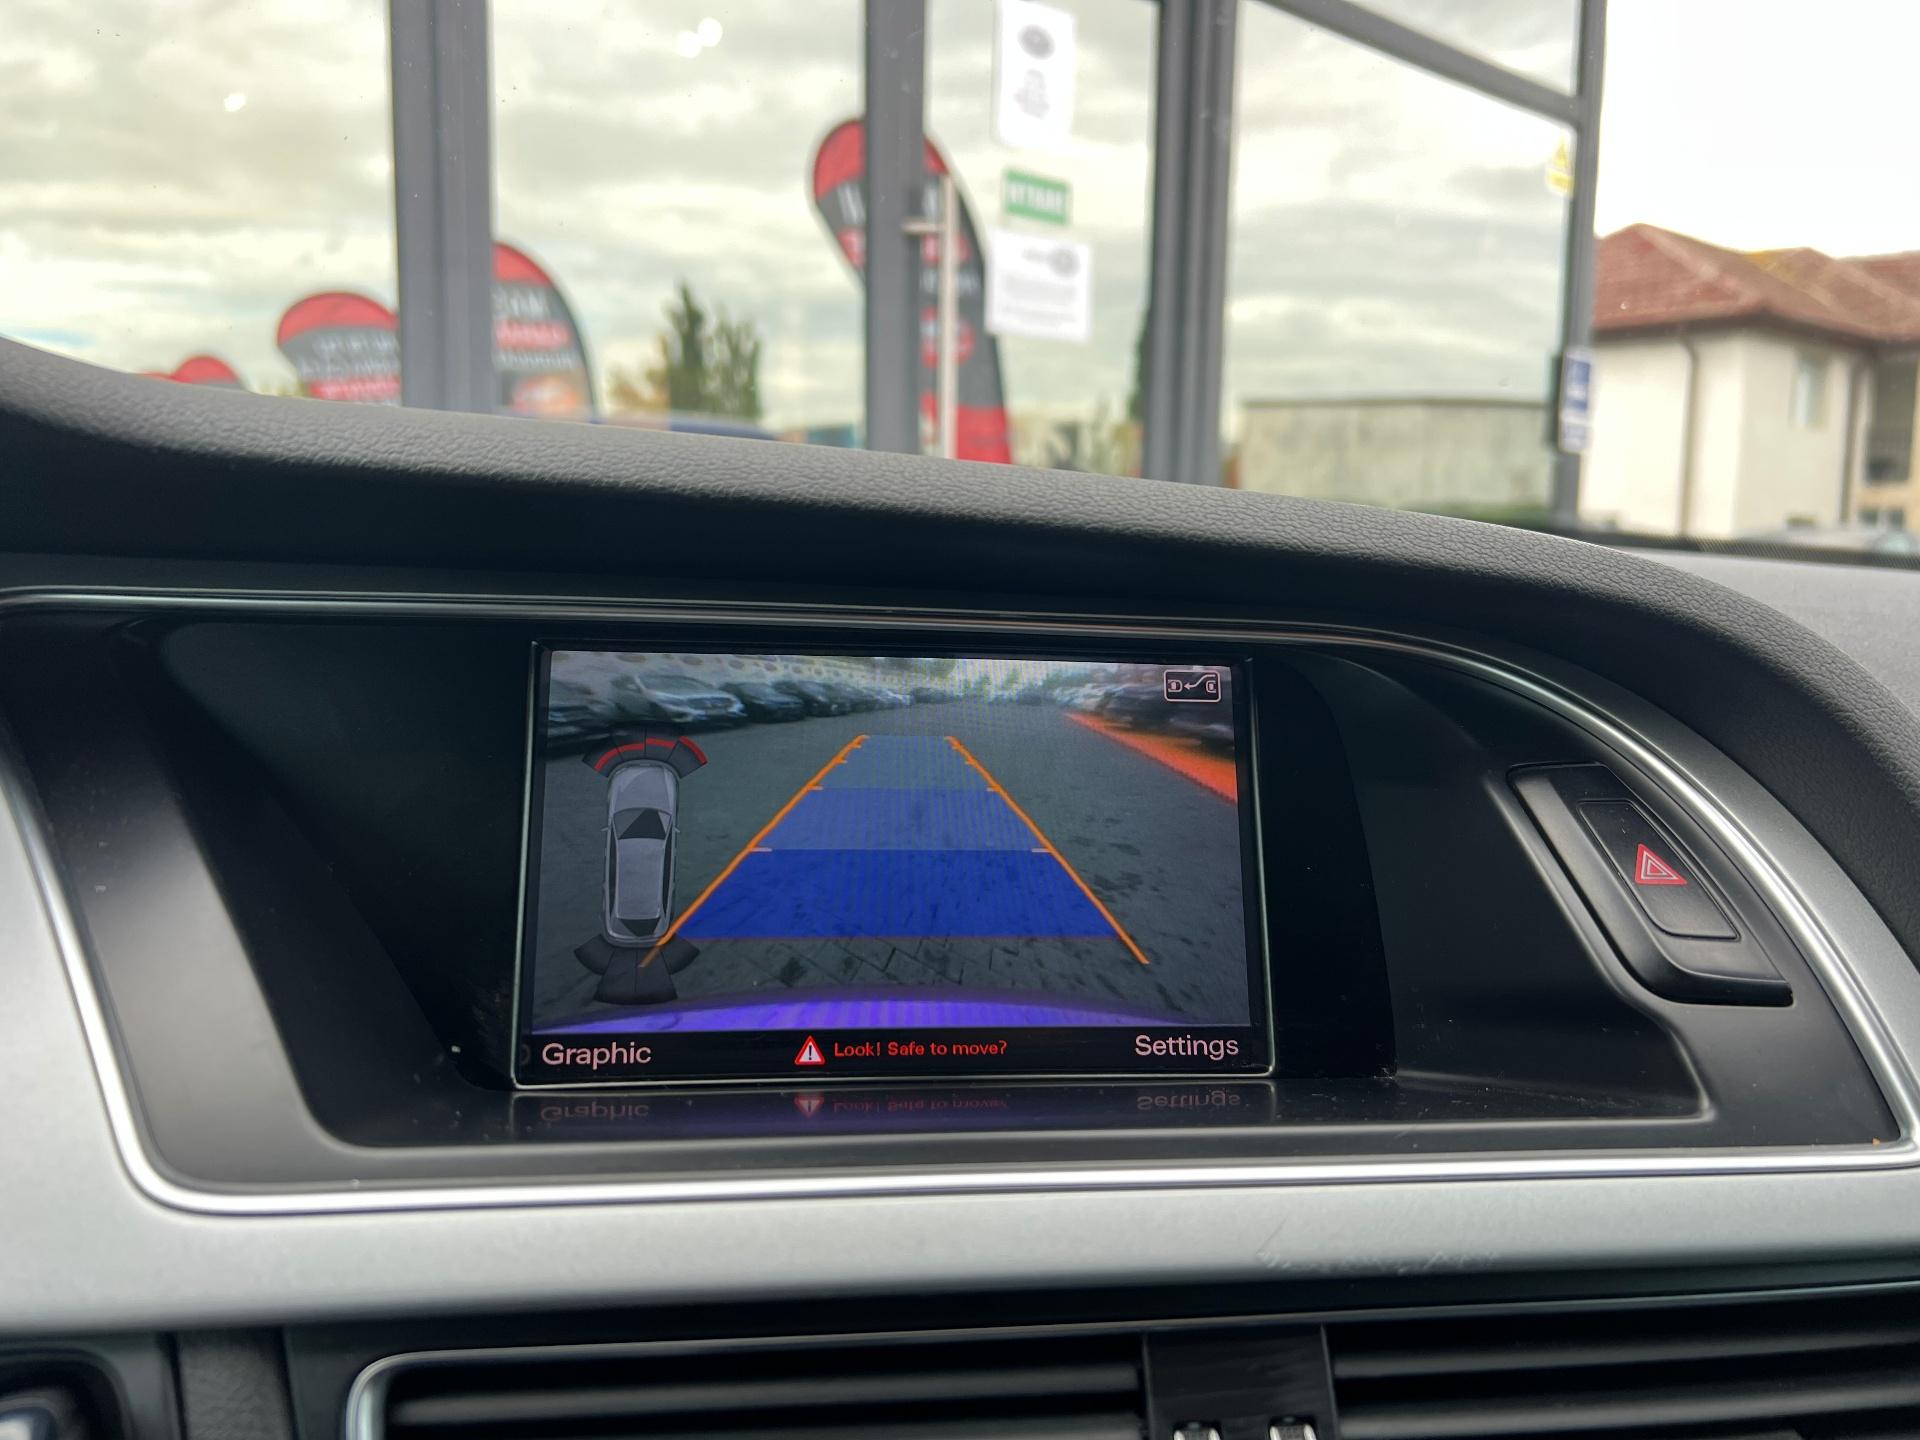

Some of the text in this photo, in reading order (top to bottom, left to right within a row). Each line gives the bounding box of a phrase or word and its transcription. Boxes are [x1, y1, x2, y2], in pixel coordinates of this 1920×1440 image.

[542, 1041, 652, 1070] Graphic
[834, 1040, 1008, 1057] Look! Safe to move?
[1135, 1034, 1239, 1060] Settings
